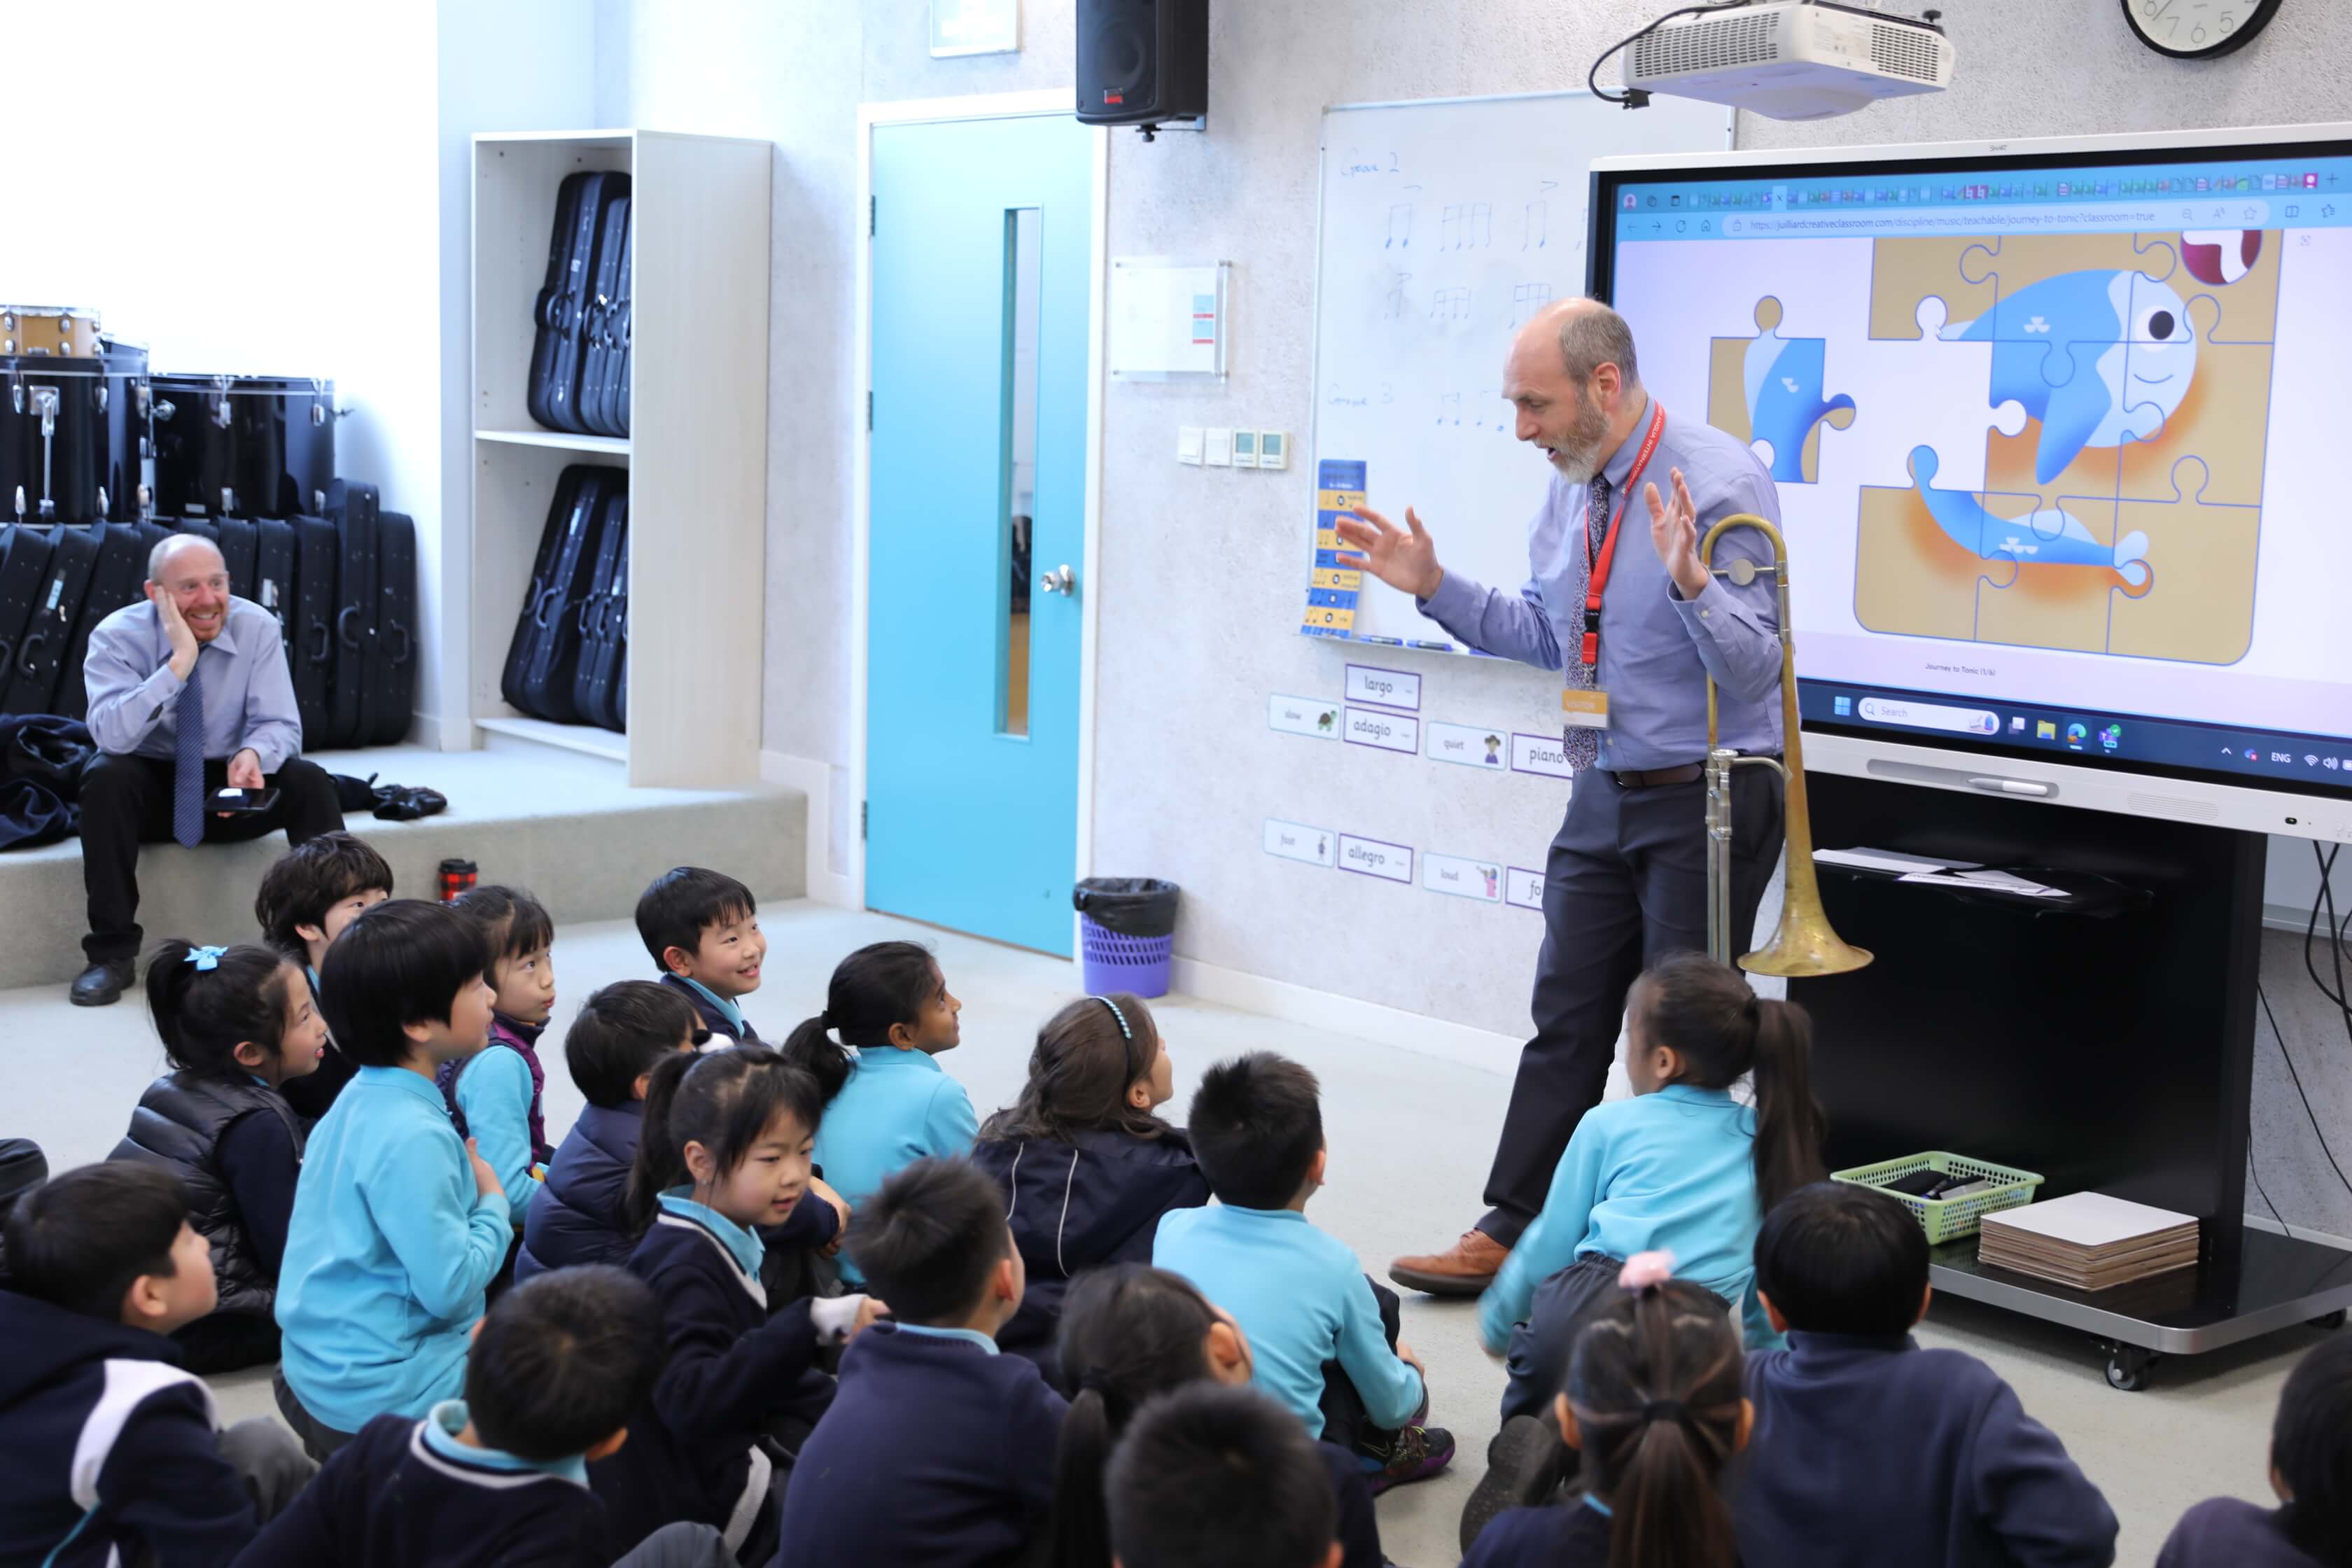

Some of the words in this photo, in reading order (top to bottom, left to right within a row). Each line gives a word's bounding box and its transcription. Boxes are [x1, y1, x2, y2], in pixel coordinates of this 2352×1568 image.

[2166, 16, 2180, 38] 7
[2190, 21, 2206, 44] 6
[2218, 10, 2234, 34] 5
[1364, 675, 1393, 698] largo
[1881, 706, 1908, 718] Search
[1353, 718, 1391, 740] adagio
[1443, 738, 1464, 751] quiet
[1529, 747, 1564, 766] piano
[2271, 751, 2292, 764] ENG
[1348, 845, 1386, 868] allegro
[1440, 867, 1459, 882] loud
